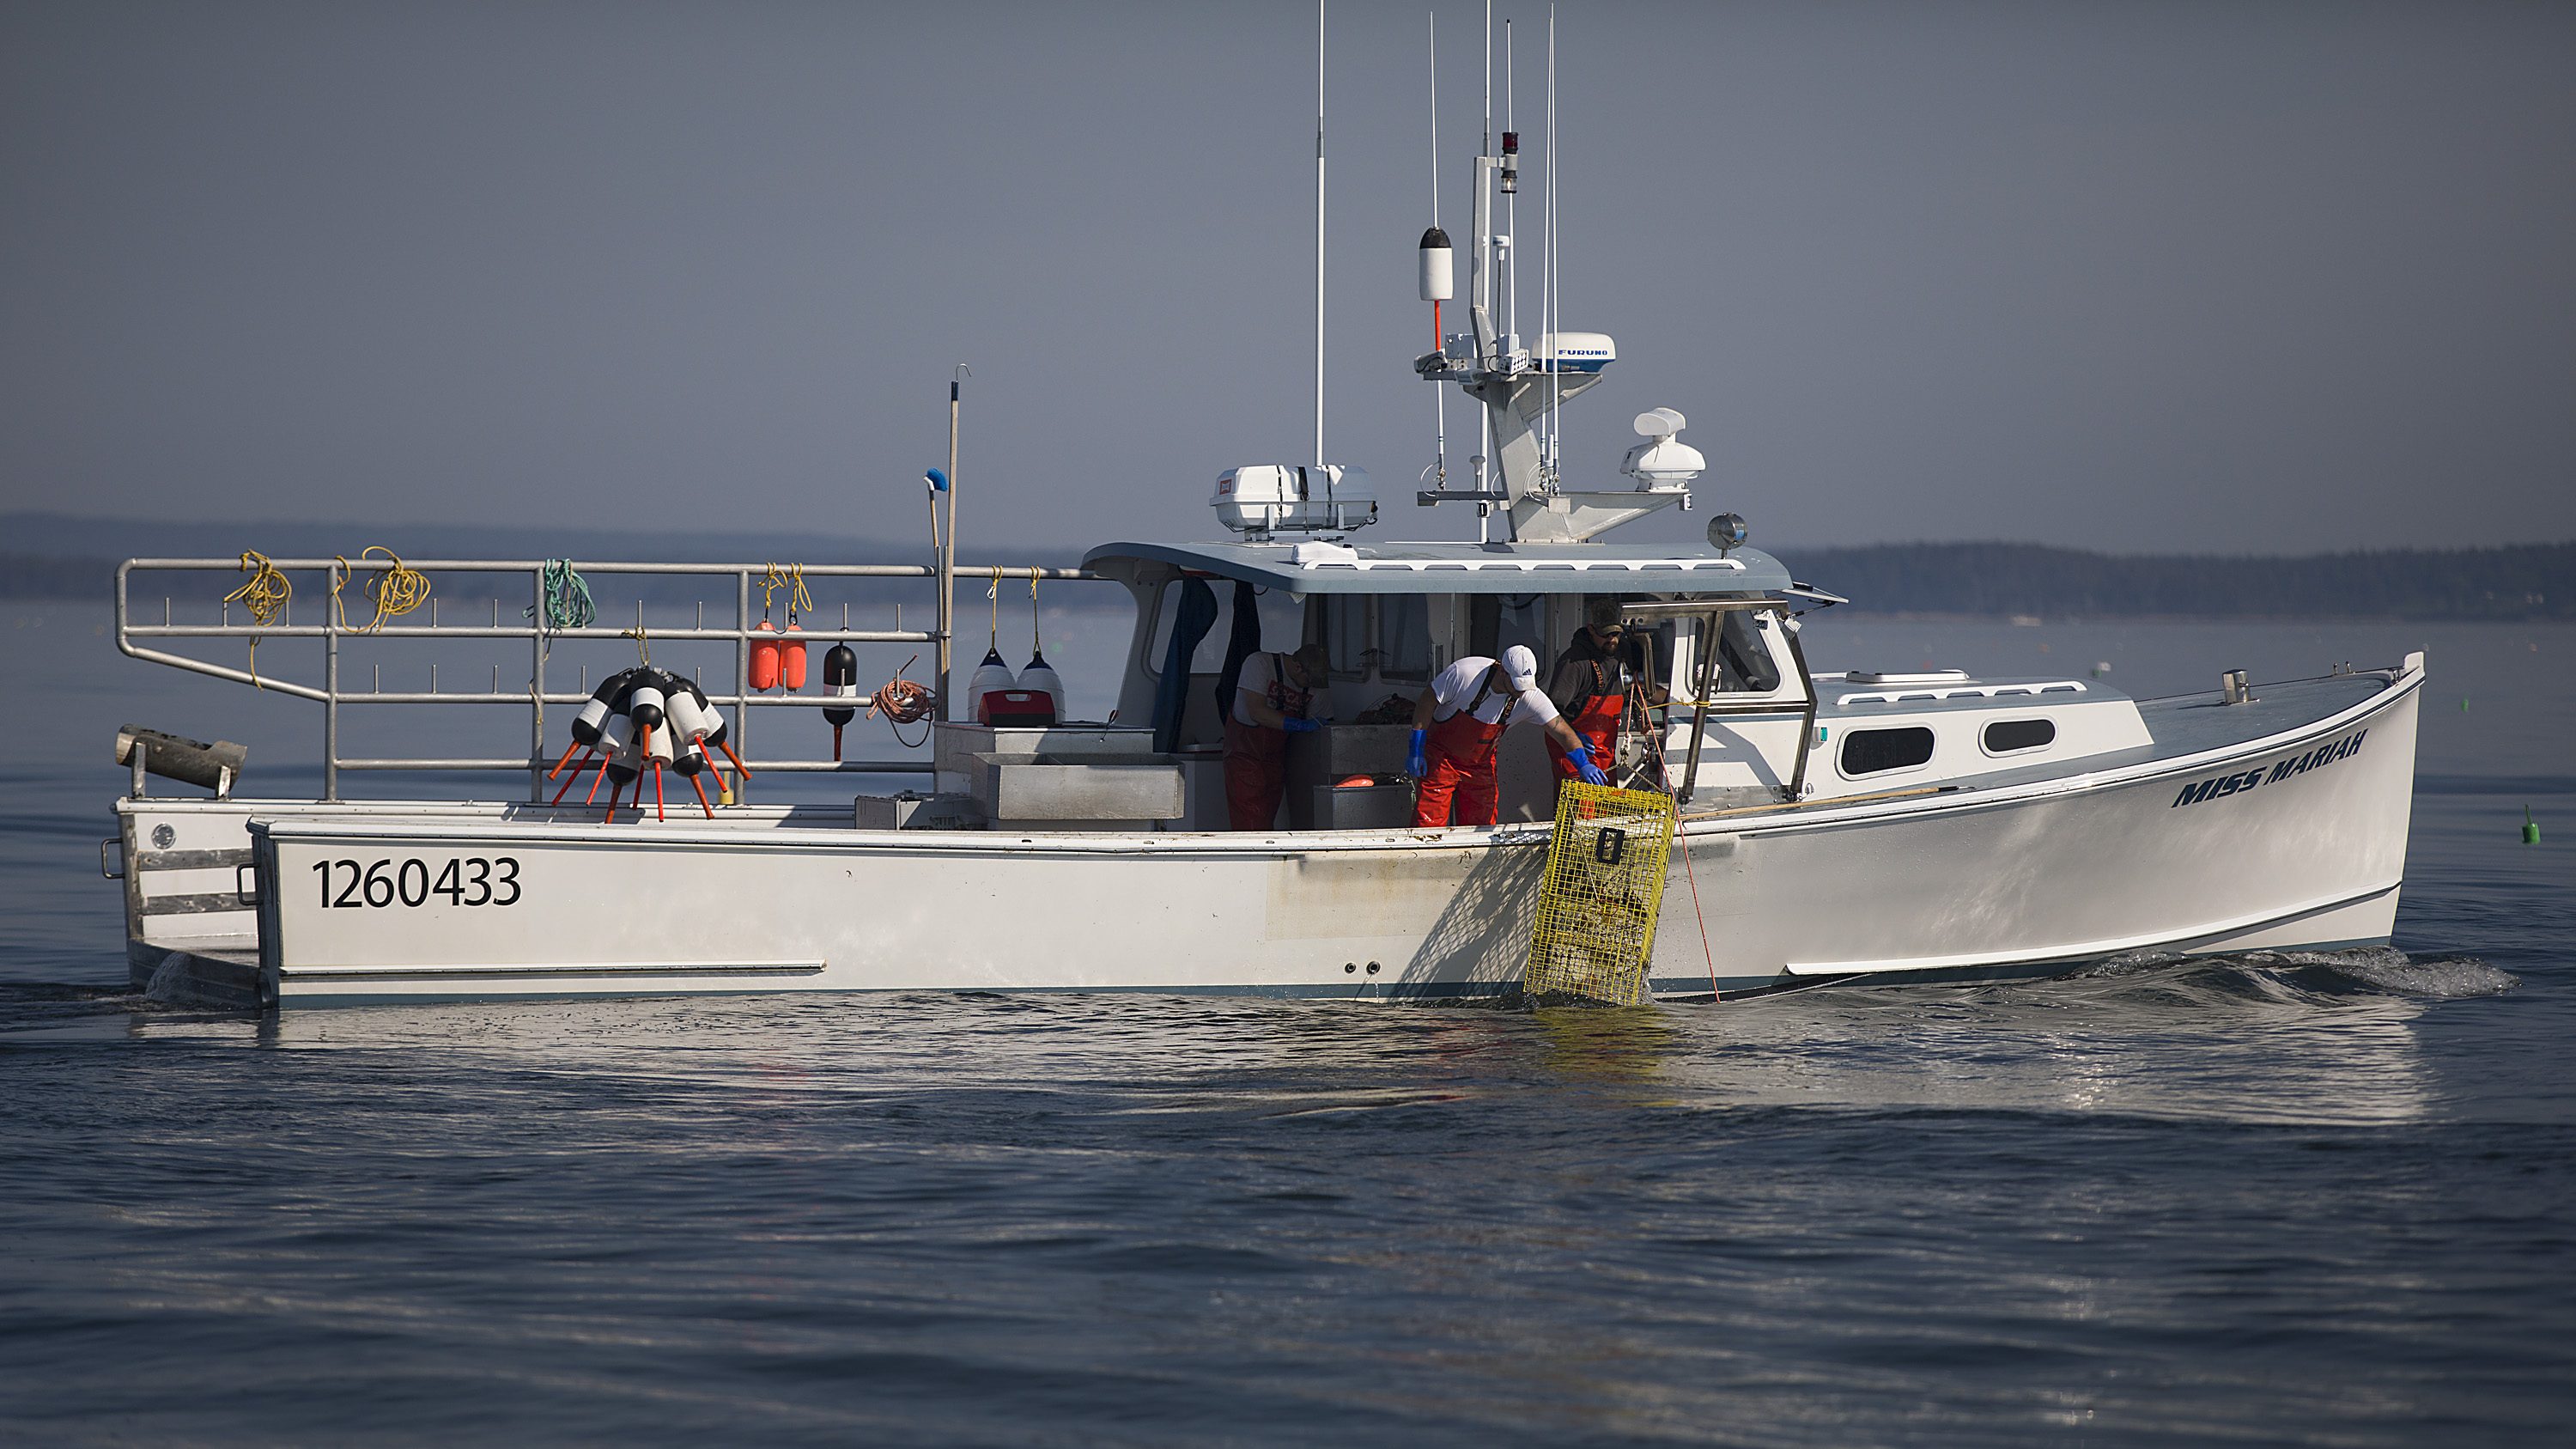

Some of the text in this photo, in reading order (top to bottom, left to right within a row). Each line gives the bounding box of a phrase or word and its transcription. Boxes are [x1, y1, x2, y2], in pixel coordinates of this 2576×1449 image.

[2171, 728, 2368, 808] MISS MARIAH
[312, 857, 521, 908] 1260433
